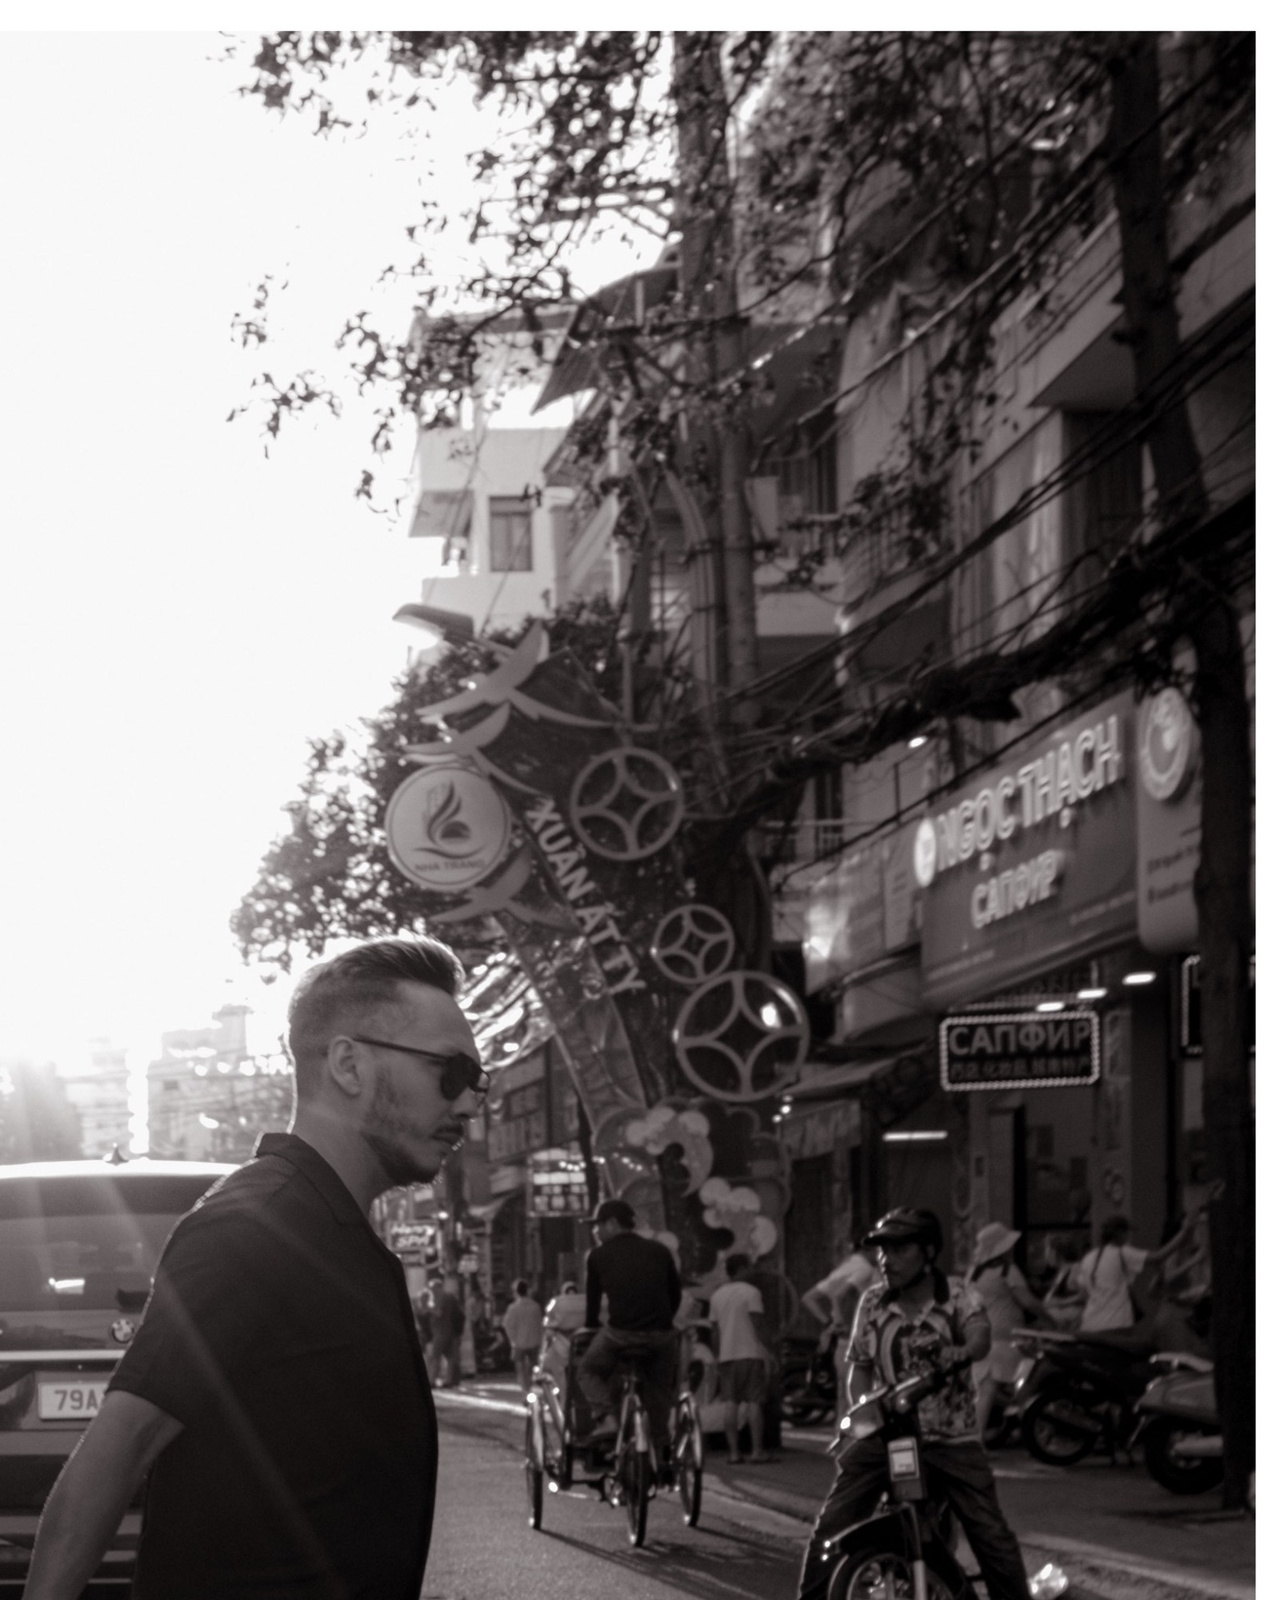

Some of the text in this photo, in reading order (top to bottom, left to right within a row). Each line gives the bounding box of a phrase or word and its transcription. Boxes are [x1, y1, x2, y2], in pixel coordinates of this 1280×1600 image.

[935, 714, 1119, 872] NGỌC THẠCH
[415, 860, 485, 871] NHA TRANG
[526, 798, 596, 901] XUÂN
[972, 850, 1060, 929] САПФИР
[949, 1022, 1091, 1055] САПФИР
